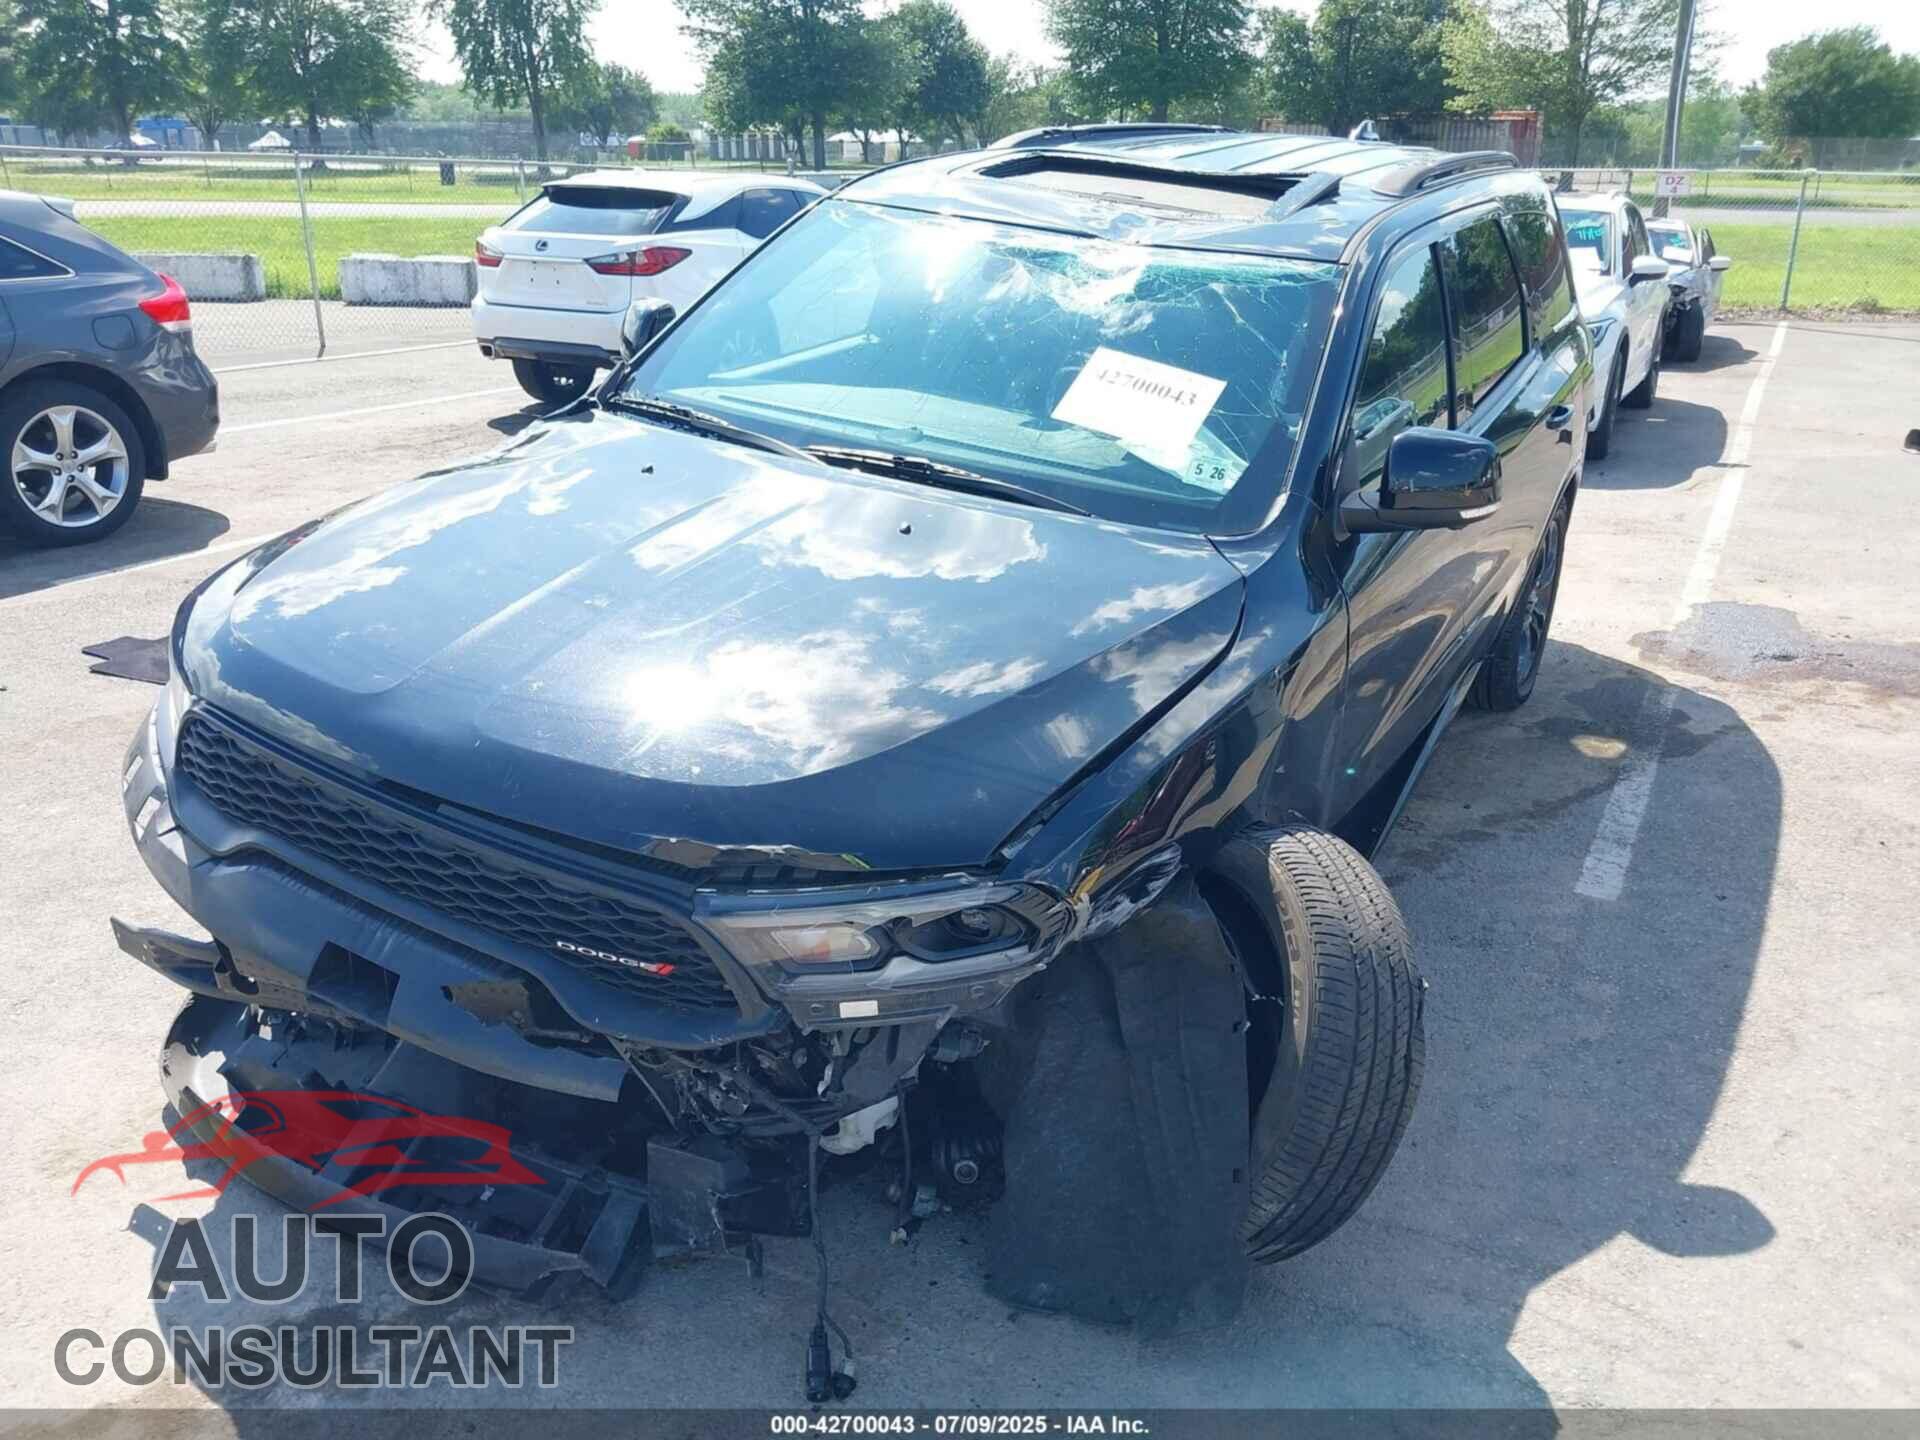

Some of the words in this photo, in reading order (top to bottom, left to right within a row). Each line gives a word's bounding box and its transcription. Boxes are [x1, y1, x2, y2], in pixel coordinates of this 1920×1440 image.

[1096, 369, 1198, 406] 42700043
[1194, 463, 1204, 476] 5
[1209, 466, 1226, 481] 26
[556, 940, 658, 973] DODGE
